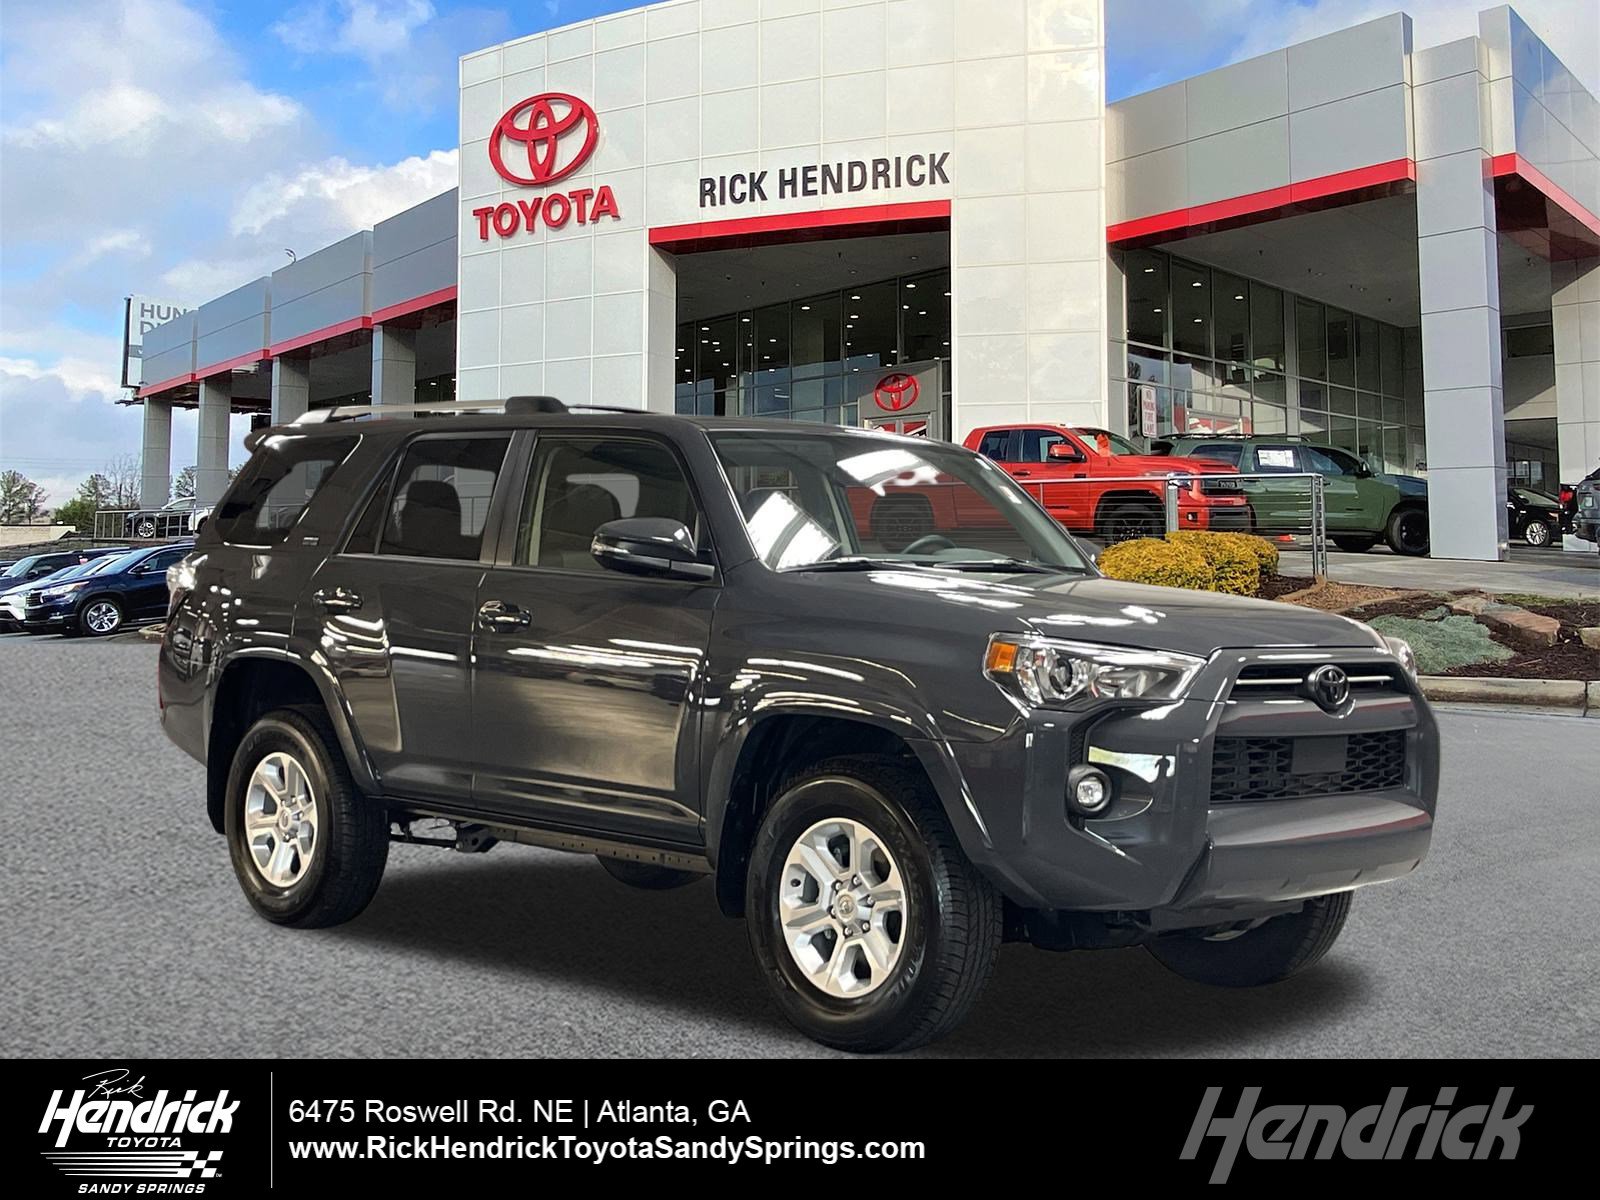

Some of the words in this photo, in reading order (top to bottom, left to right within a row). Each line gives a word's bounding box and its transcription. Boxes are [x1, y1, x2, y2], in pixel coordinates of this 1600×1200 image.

[699, 170, 768, 208] RICK
[778, 152, 950, 199] HENDRICK
[473, 185, 620, 240] TOYOTA
